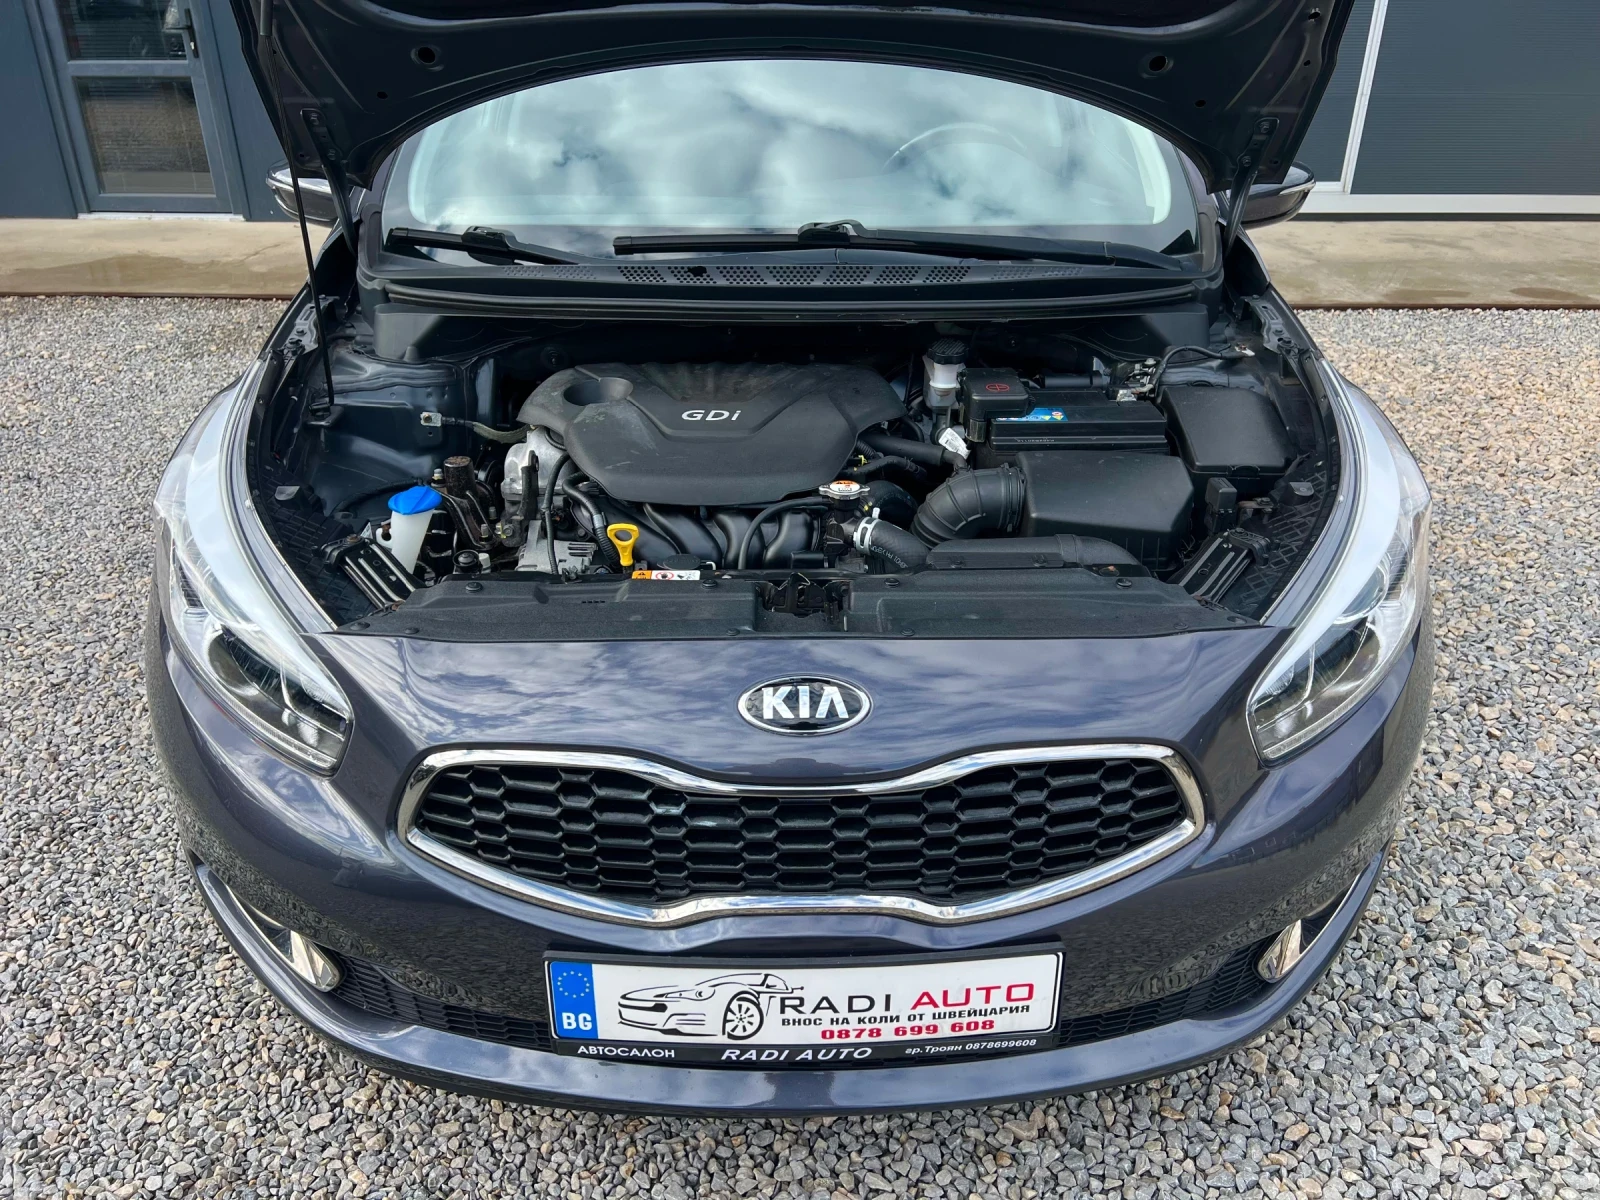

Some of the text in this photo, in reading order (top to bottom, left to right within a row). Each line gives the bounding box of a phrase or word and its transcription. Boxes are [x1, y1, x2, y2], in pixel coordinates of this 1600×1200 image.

[681, 409, 742, 421] GDi
[761, 685, 850, 720] KIA
[779, 982, 1035, 1015] RADI AUTO
[561, 1011, 593, 1031] BG
[781, 1004, 1031, 1027] ВНОС НА КОЛИ ОТ ШВЕЙЦАРИЯ
[820, 1019, 995, 1040] 0878 699 608
[577, 1045, 676, 1059] АВТОСАЛОН
[720, 1047, 873, 1062] RADI AUTO
[904, 1038, 1037, 1055] гр.Троян 0878699608
